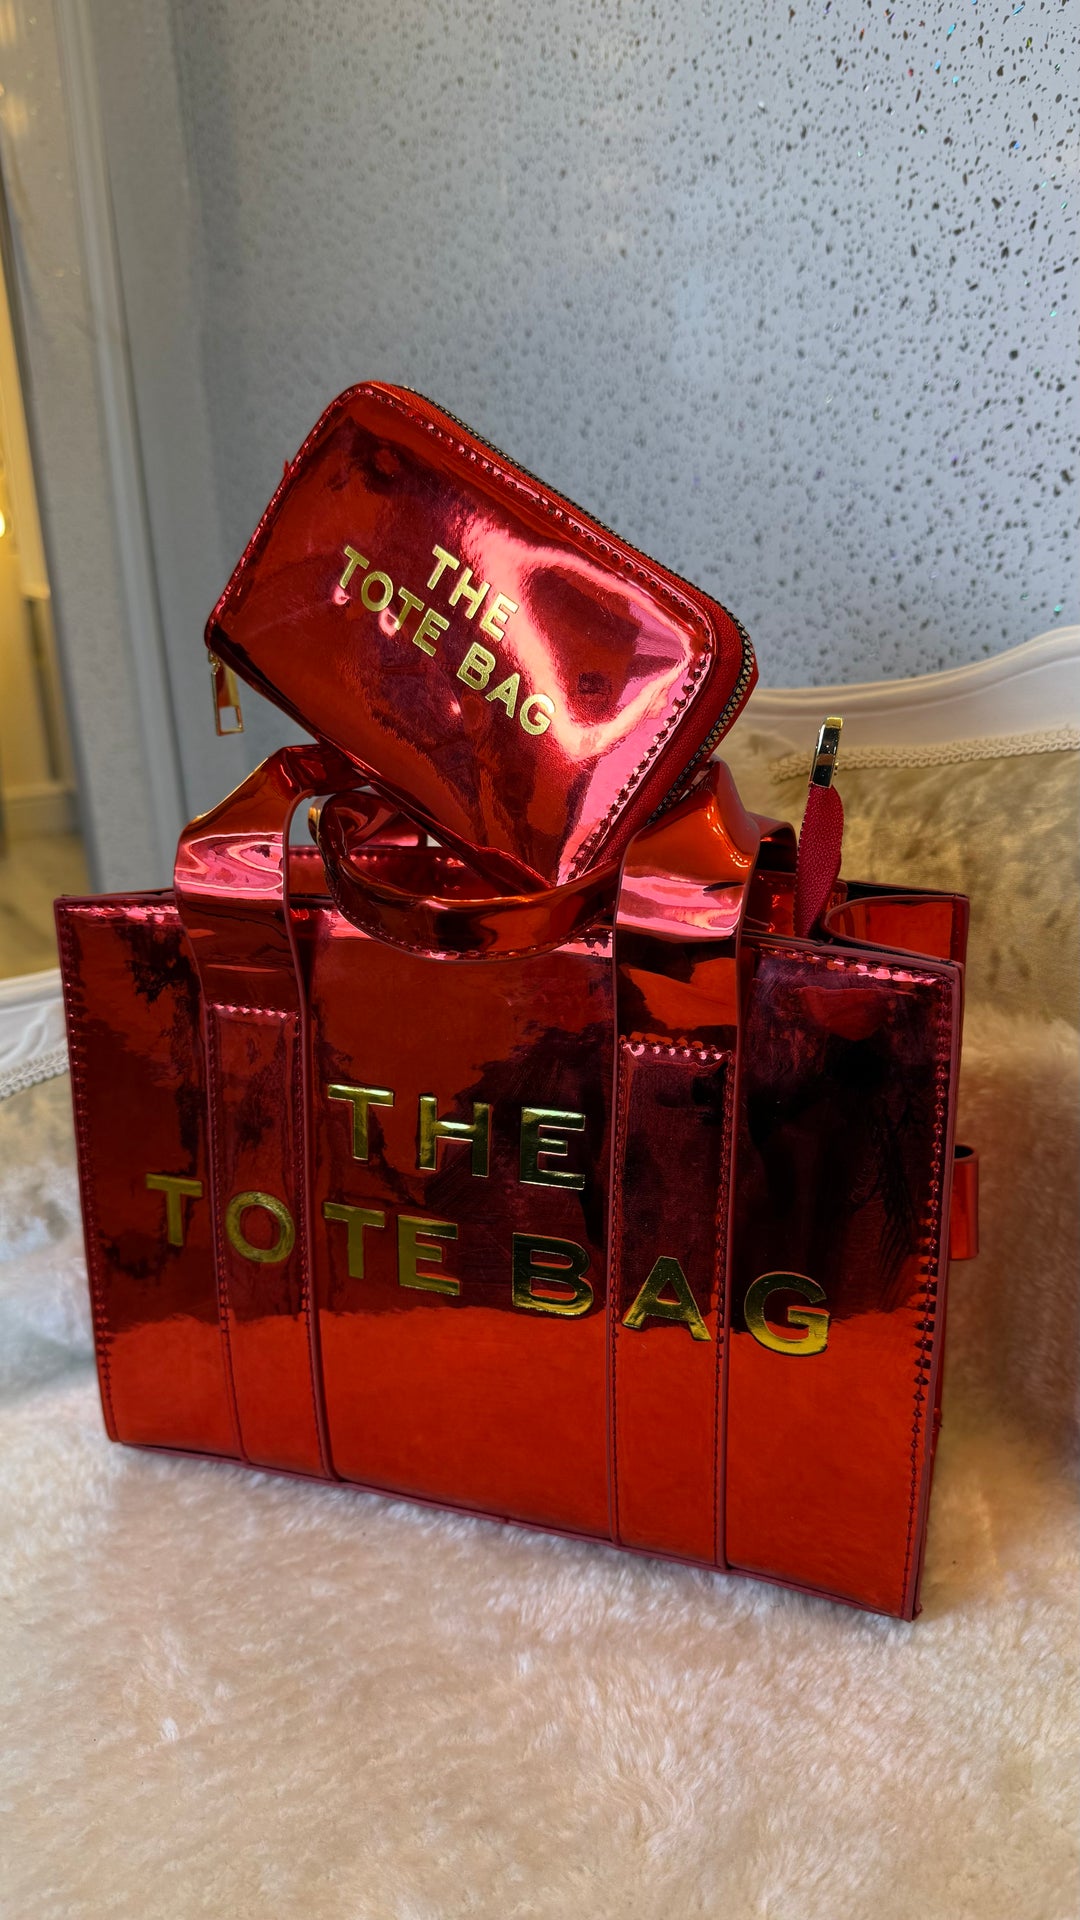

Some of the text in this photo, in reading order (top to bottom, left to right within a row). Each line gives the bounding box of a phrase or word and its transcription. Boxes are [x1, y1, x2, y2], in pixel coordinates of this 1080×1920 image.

[339, 544, 556, 735] TOTE BAG
[427, 544, 519, 641] THE
[327, 1083, 586, 1191] THE
[146, 1172, 830, 1357] TOTE BAG
